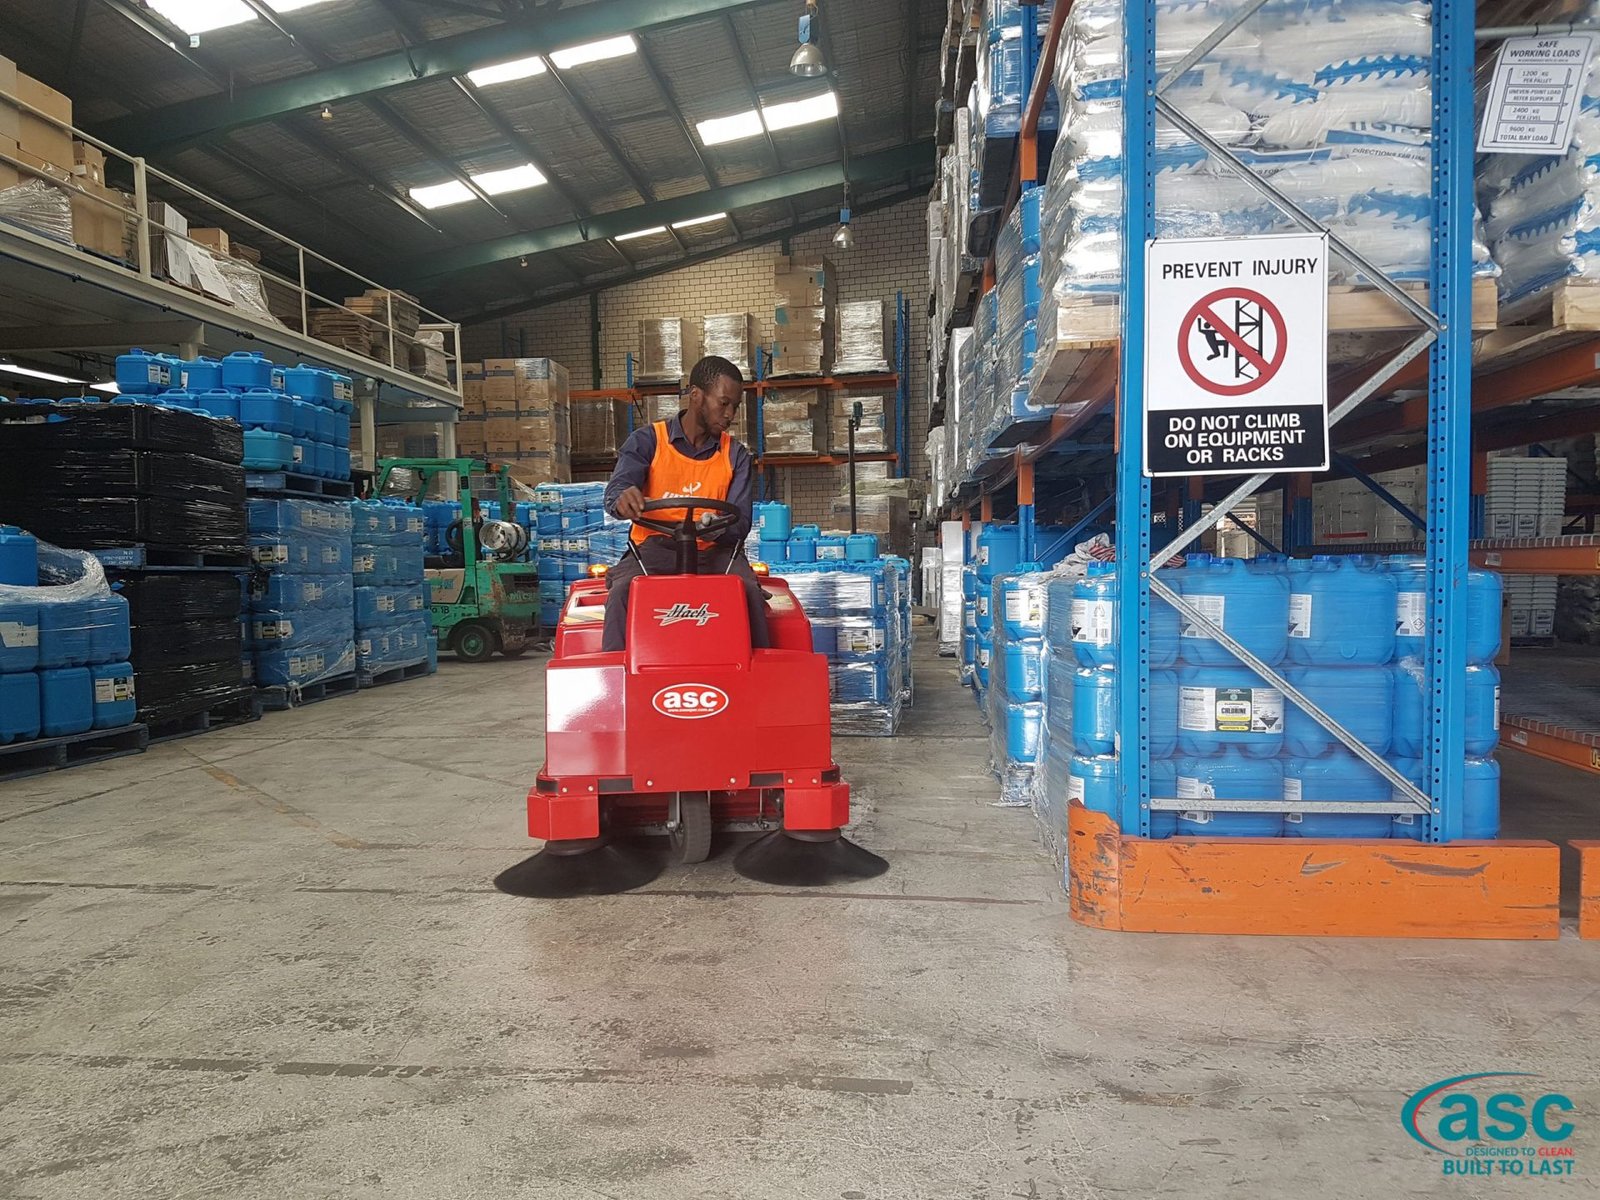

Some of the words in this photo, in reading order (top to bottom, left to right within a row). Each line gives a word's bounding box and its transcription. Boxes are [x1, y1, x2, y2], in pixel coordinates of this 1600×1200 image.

[1537, 40, 1559, 48] SAFE
[1510, 50, 1551, 58] WORKING
[1552, 49, 1580, 57] LOADS
[1162, 260, 1243, 280] PREVENT
[1252, 257, 1319, 276] INJURY
[1168, 416, 1196, 432] DO
[1200, 414, 1241, 430] NOT
[1244, 412, 1301, 429] CLIMB
[1164, 433, 1192, 449] ON
[1197, 429, 1306, 449] EQUIPMENT
[1186, 449, 1213, 464] OR
[1222, 446, 1284, 463] RACKS
[662, 691, 718, 709] asc
[1221, 707, 1246, 715] CHLORINE
